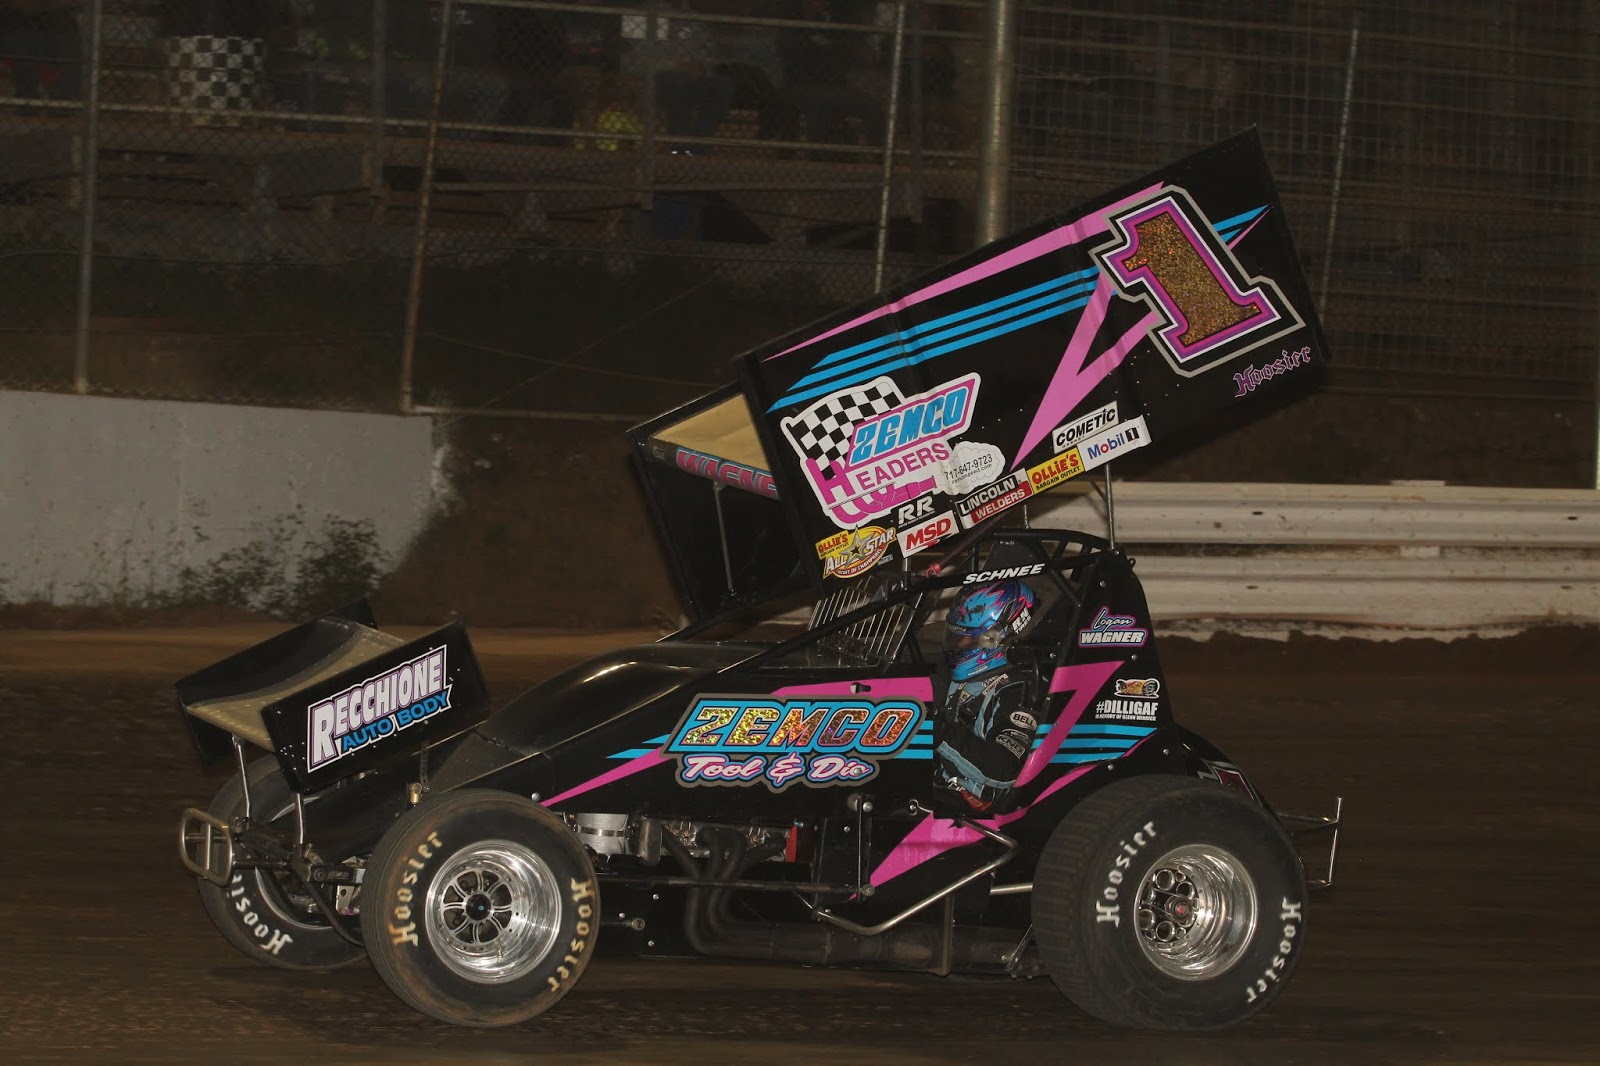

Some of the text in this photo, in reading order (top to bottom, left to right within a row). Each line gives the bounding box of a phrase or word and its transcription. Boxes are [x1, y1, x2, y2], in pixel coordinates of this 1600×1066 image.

[1102, 196, 1281, 362] 1
[1233, 346, 1310, 398] Hoosier
[850, 388, 967, 465] ZEMCO
[1056, 408, 1116, 447] COMETIC
[1087, 432, 1125, 460] Mobil
[943, 453, 993, 481] 717-647-9723
[1060, 465, 1080, 479] OUTLET
[960, 477, 1015, 515] LINCOLN
[975, 488, 1025, 520] WELDERS
[865, 528, 896, 557] STAR
[906, 518, 952, 550] MSD
[963, 563, 1045, 585] SCHNEE
[1080, 631, 1145, 644] WAGNER
[1094, 607, 1133, 633] Logan
[312, 651, 443, 766] RECCHIONE
[342, 691, 448, 751] AUTO BODY
[680, 706, 914, 747] ZEMCO
[1096, 700, 1158, 716] #DILLIGAF
[684, 751, 870, 785] Tool & Die
[391, 830, 444, 948] Hoosier
[1096, 821, 1157, 928] Hoosier
[547, 876, 593, 993] Hoosier
[1245, 896, 1302, 1003] Hoosier
